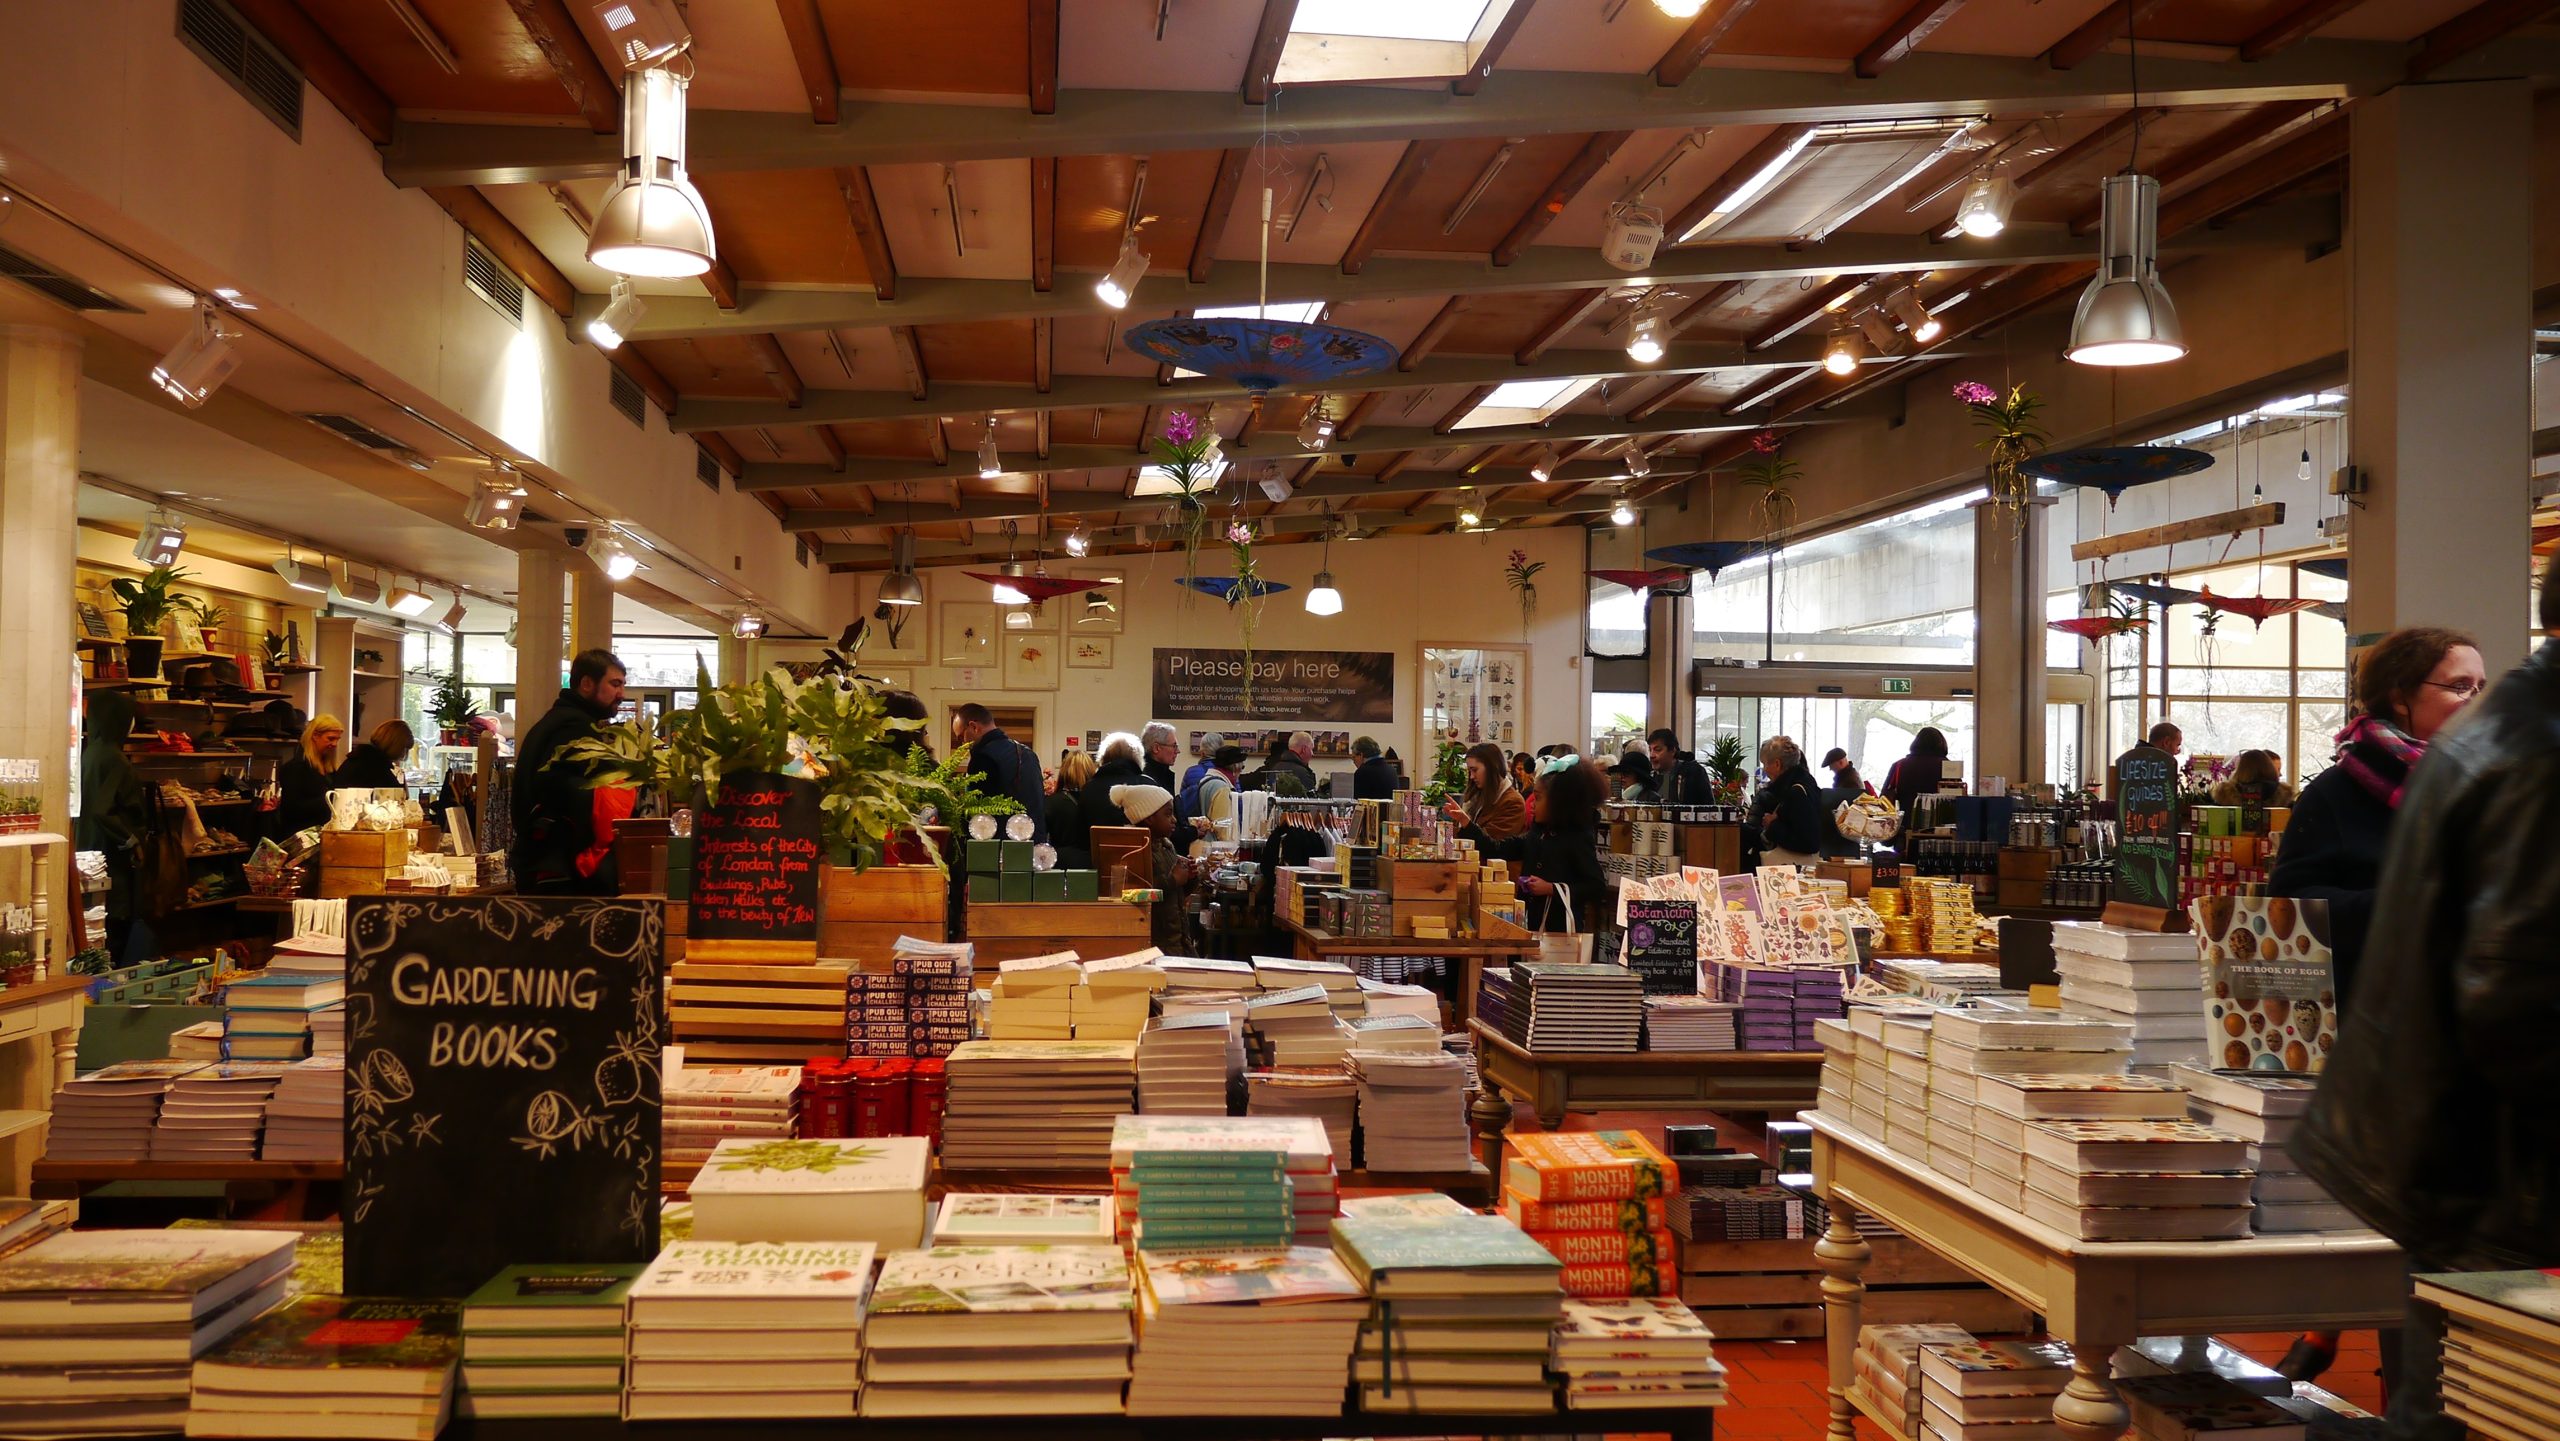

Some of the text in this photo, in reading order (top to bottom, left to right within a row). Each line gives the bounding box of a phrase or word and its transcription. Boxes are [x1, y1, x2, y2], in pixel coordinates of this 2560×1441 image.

[1170, 656, 1340, 682] Please pay here
[1169, 684, 1189, 692] Thank
[1204, 684, 1213, 692] for
[1214, 685, 1244, 693] shopping
[1306, 687, 1337, 695] purchase
[1338, 687, 1356, 695] helps
[1212, 704, 1229, 713] shop
[1259, 705, 1302, 714] shop.kew.org
[717, 785, 793, 807] Discover
[701, 811, 782, 829] the Local
[700, 834, 817, 859] Interests of the City
[697, 854, 809, 879] of London from
[700, 908, 712, 920] to
[718, 908, 737, 920] the
[777, 905, 793, 926] of
[1628, 904, 1696, 919] Botanicum
[2230, 965, 2327, 976] THE BOOK OF EGGS
[391, 953, 599, 1011] GARDENING
[429, 1021, 558, 1070] BOOKS
[1573, 1169, 1631, 1184] MONTH
[1573, 1184, 1631, 1198] MONTH
[1555, 1202, 1614, 1217] MONTH
[1555, 1217, 1614, 1230] MONTH
[1565, 1236, 1623, 1250] MONTH
[1565, 1250, 1623, 1264] MONTH
[1567, 1268, 1626, 1283] MONTH
[1567, 1282, 1626, 1295] MONTH
